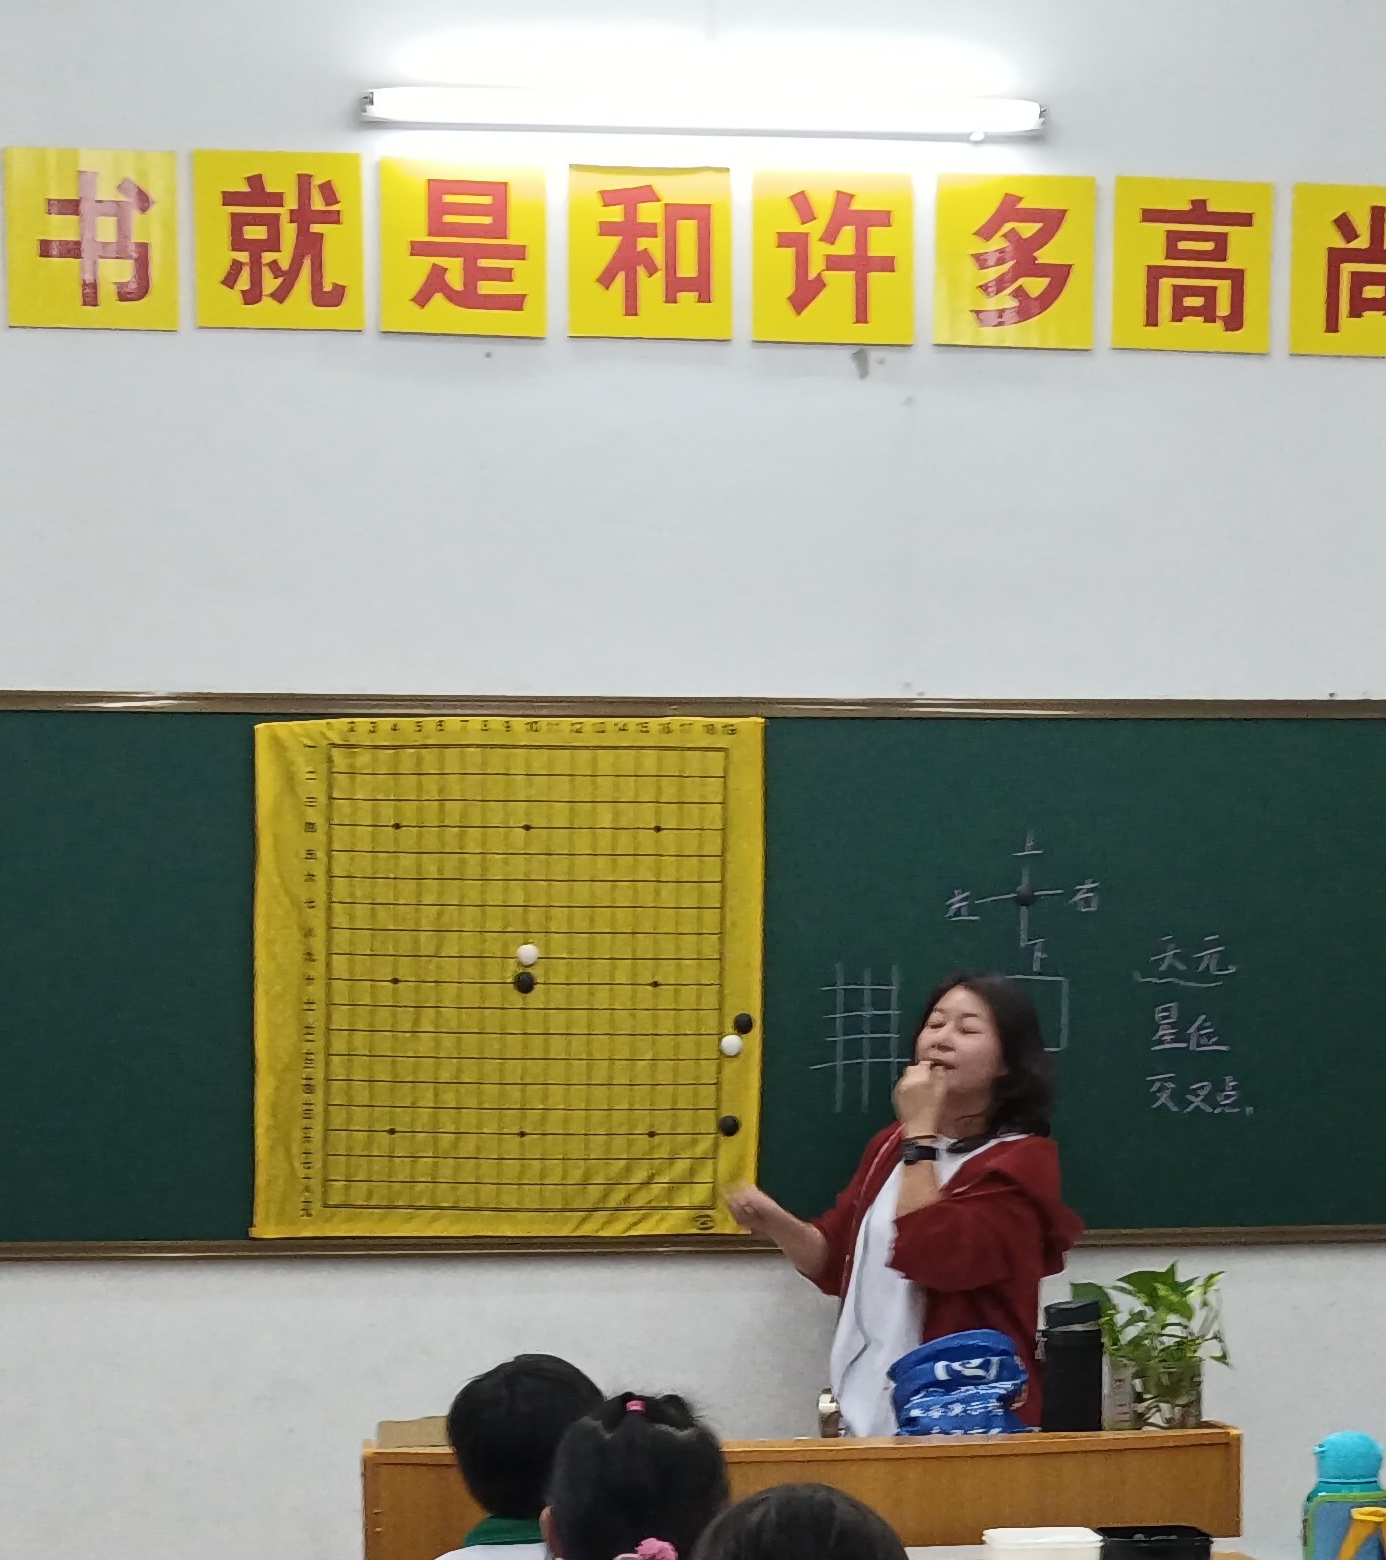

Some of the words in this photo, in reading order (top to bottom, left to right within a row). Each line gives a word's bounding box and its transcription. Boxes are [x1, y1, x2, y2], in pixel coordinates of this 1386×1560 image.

[944, 888, 981, 921] 左
[1068, 878, 1101, 912] 右
[1024, 938, 1048, 972] 下
[1149, 934, 1237, 975] 天元
[1150, 1001, 1231, 1051] 星位
